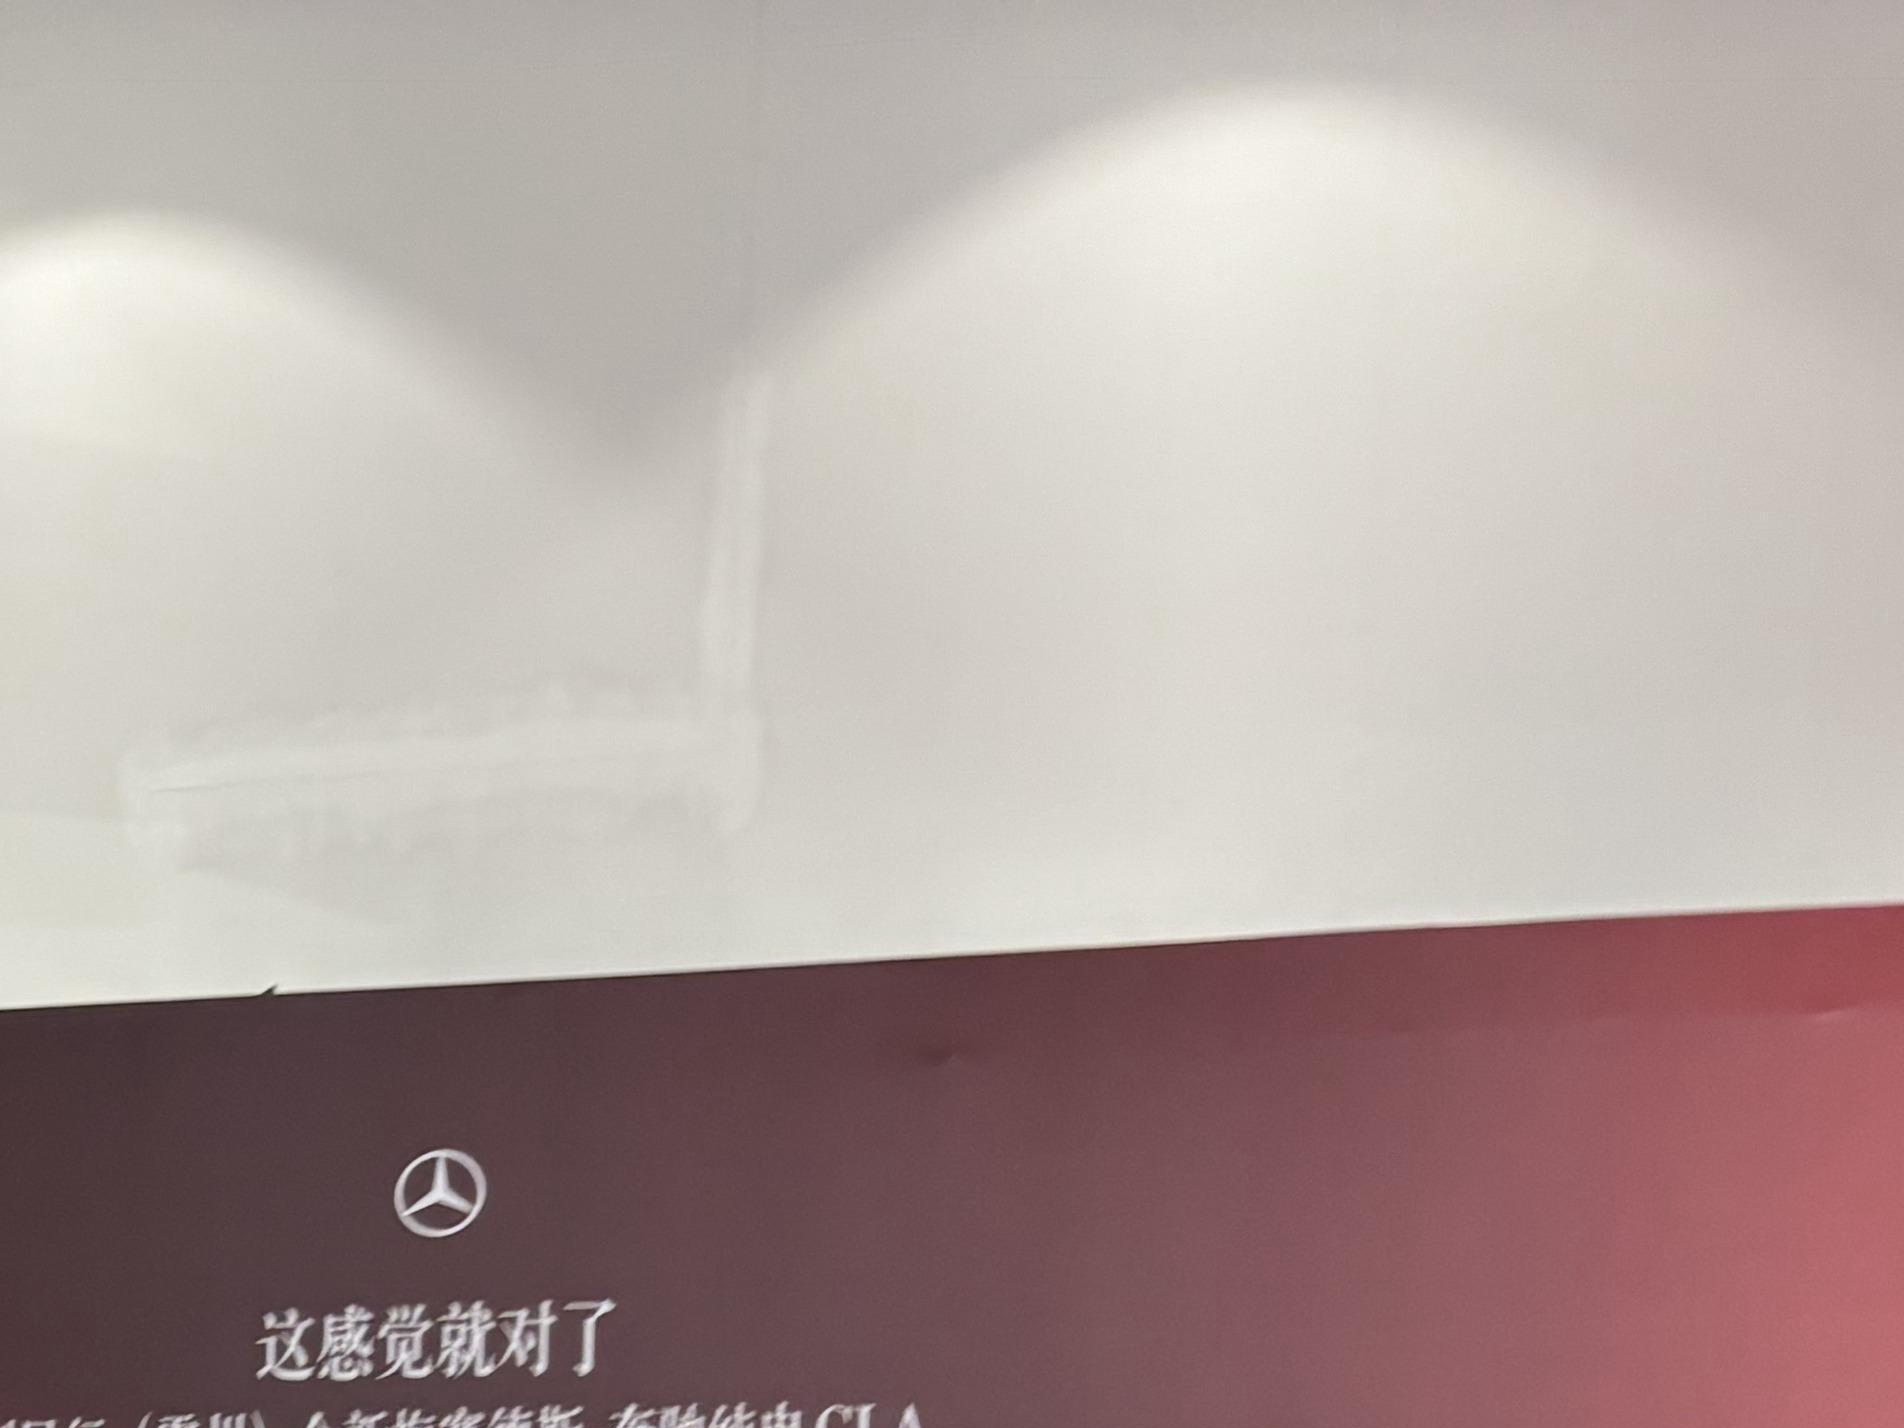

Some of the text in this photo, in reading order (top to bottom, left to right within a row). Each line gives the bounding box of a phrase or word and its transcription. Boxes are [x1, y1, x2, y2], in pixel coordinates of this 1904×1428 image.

[255, 1298, 617, 1382] 这感觉就对了
